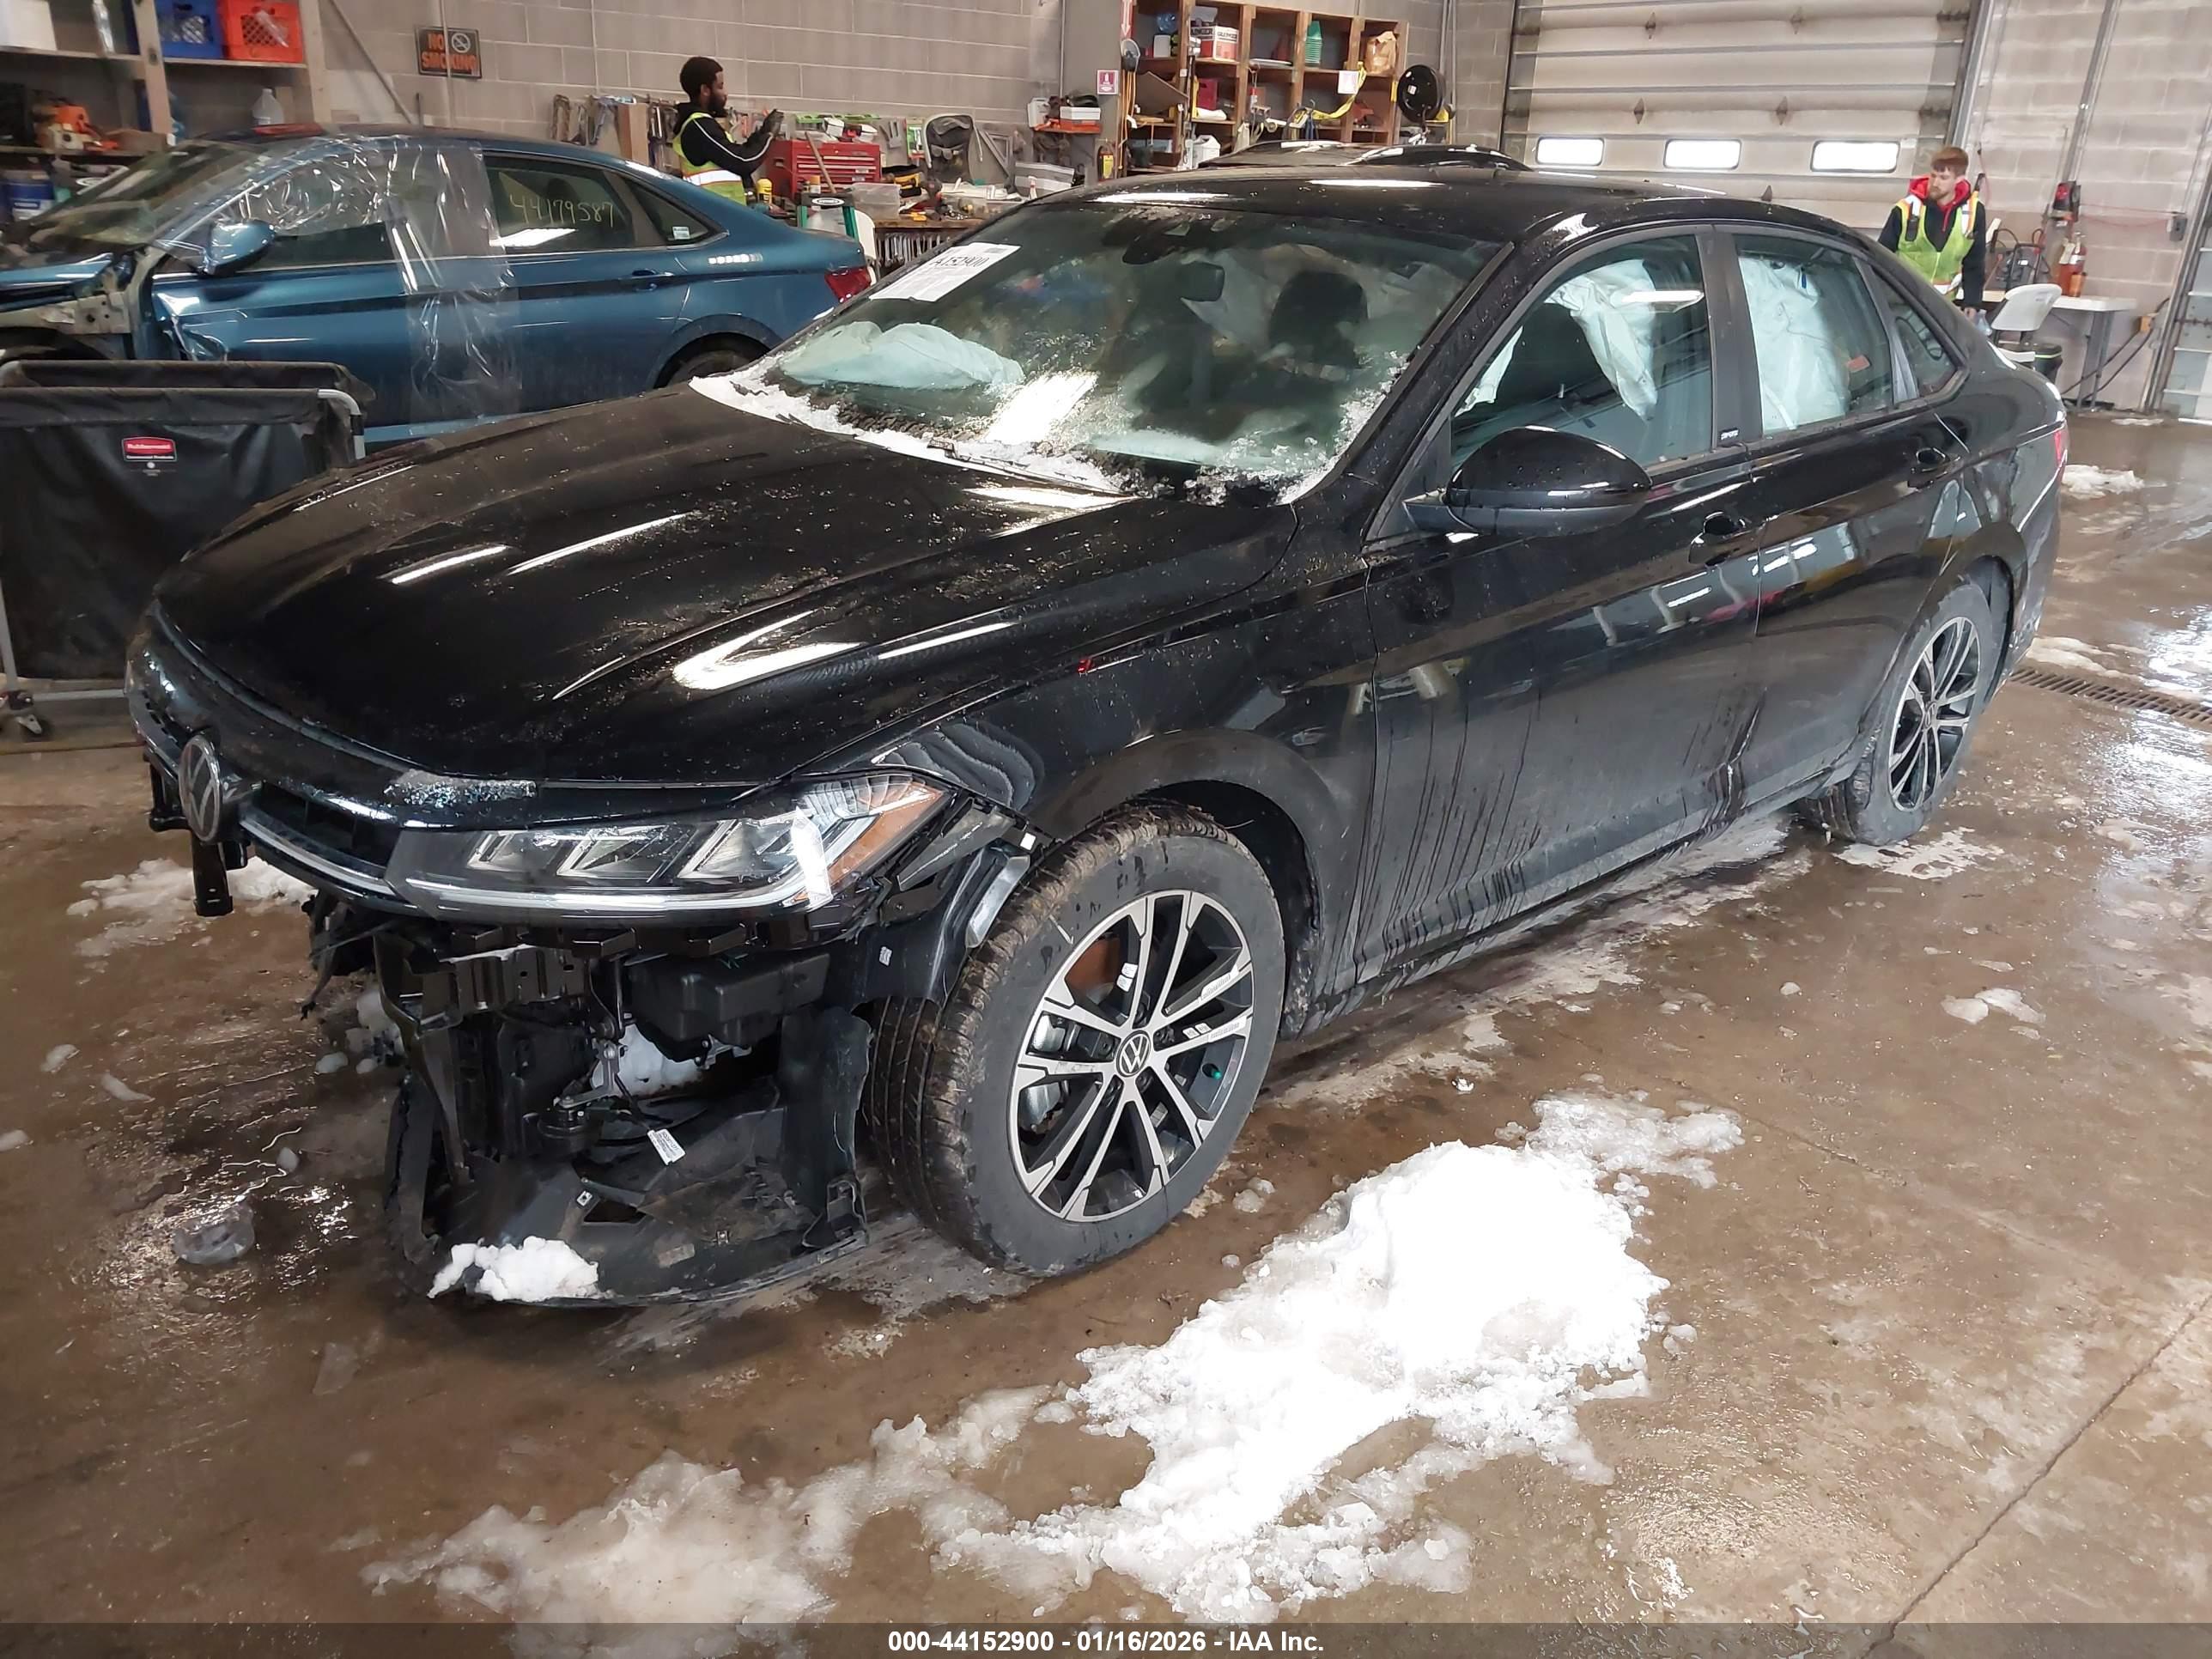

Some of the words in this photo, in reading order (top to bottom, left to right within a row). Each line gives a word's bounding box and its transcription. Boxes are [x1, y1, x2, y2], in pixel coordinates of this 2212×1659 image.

[427, 33, 445, 50] NO
[422, 52, 477, 70] SMOKING
[509, 193, 614, 228] 44179587
